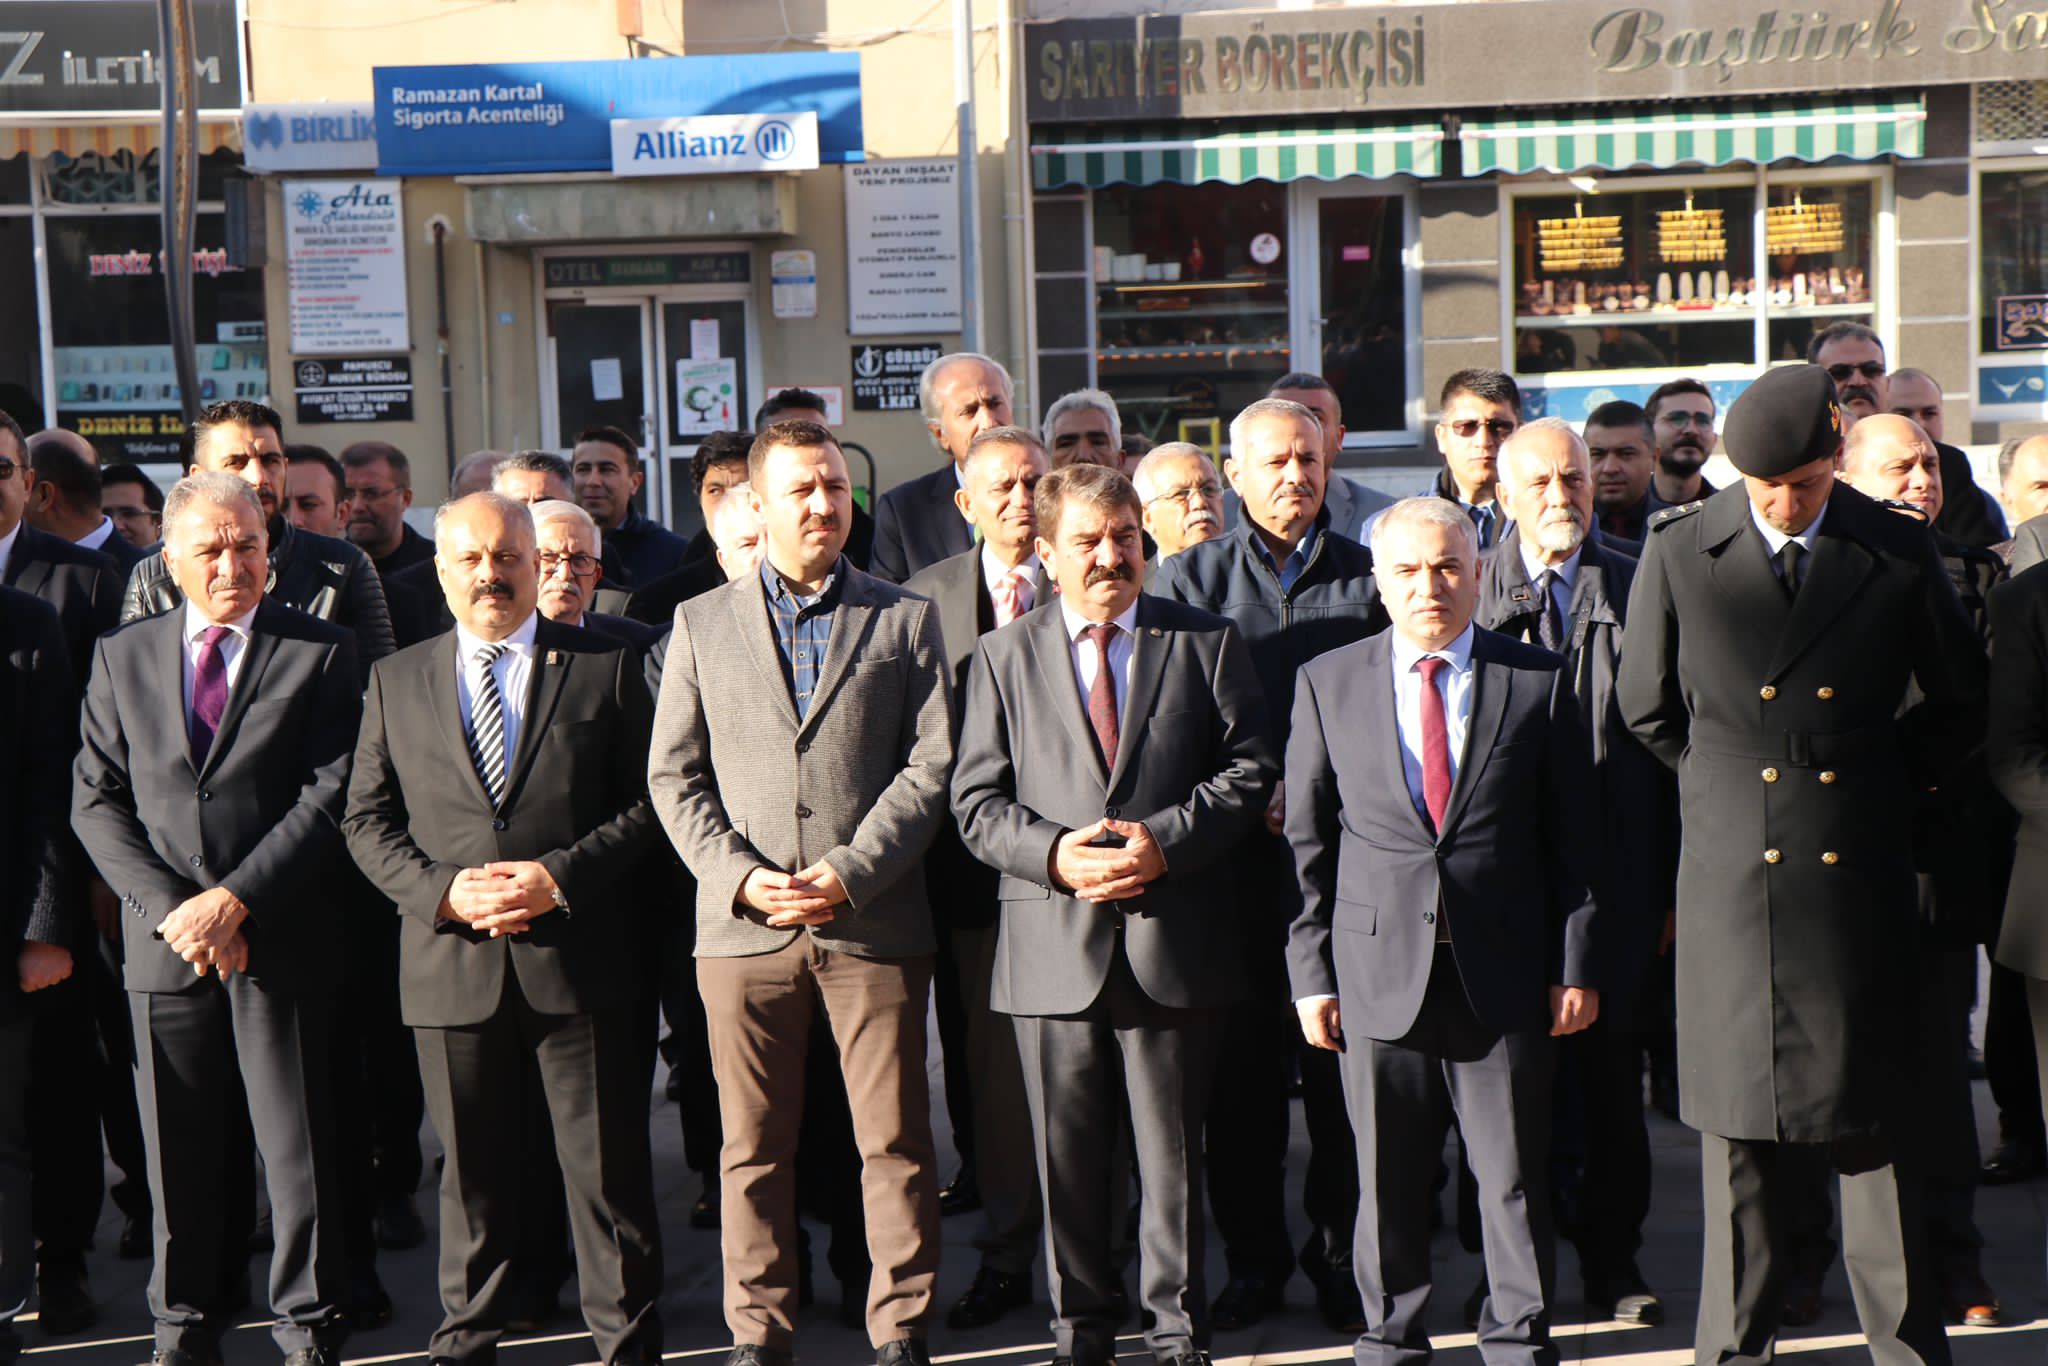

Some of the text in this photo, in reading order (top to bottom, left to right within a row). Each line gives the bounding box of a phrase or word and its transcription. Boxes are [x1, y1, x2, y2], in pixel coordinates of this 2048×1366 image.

[1590, 0, 1922, 83] Baştürk
[62, 50, 220, 85] İLETİM
[1039, 16, 1425, 105] SARIYER BÖREKÇİSİ
[392, 82, 544, 105] Ramazan Kartal
[393, 104, 564, 130] Sigorta Acenteliği
[633, 131, 747, 161] Allianz
[88, 249, 153, 276] DENİZ
[78, 414, 153, 436] DENİZ
